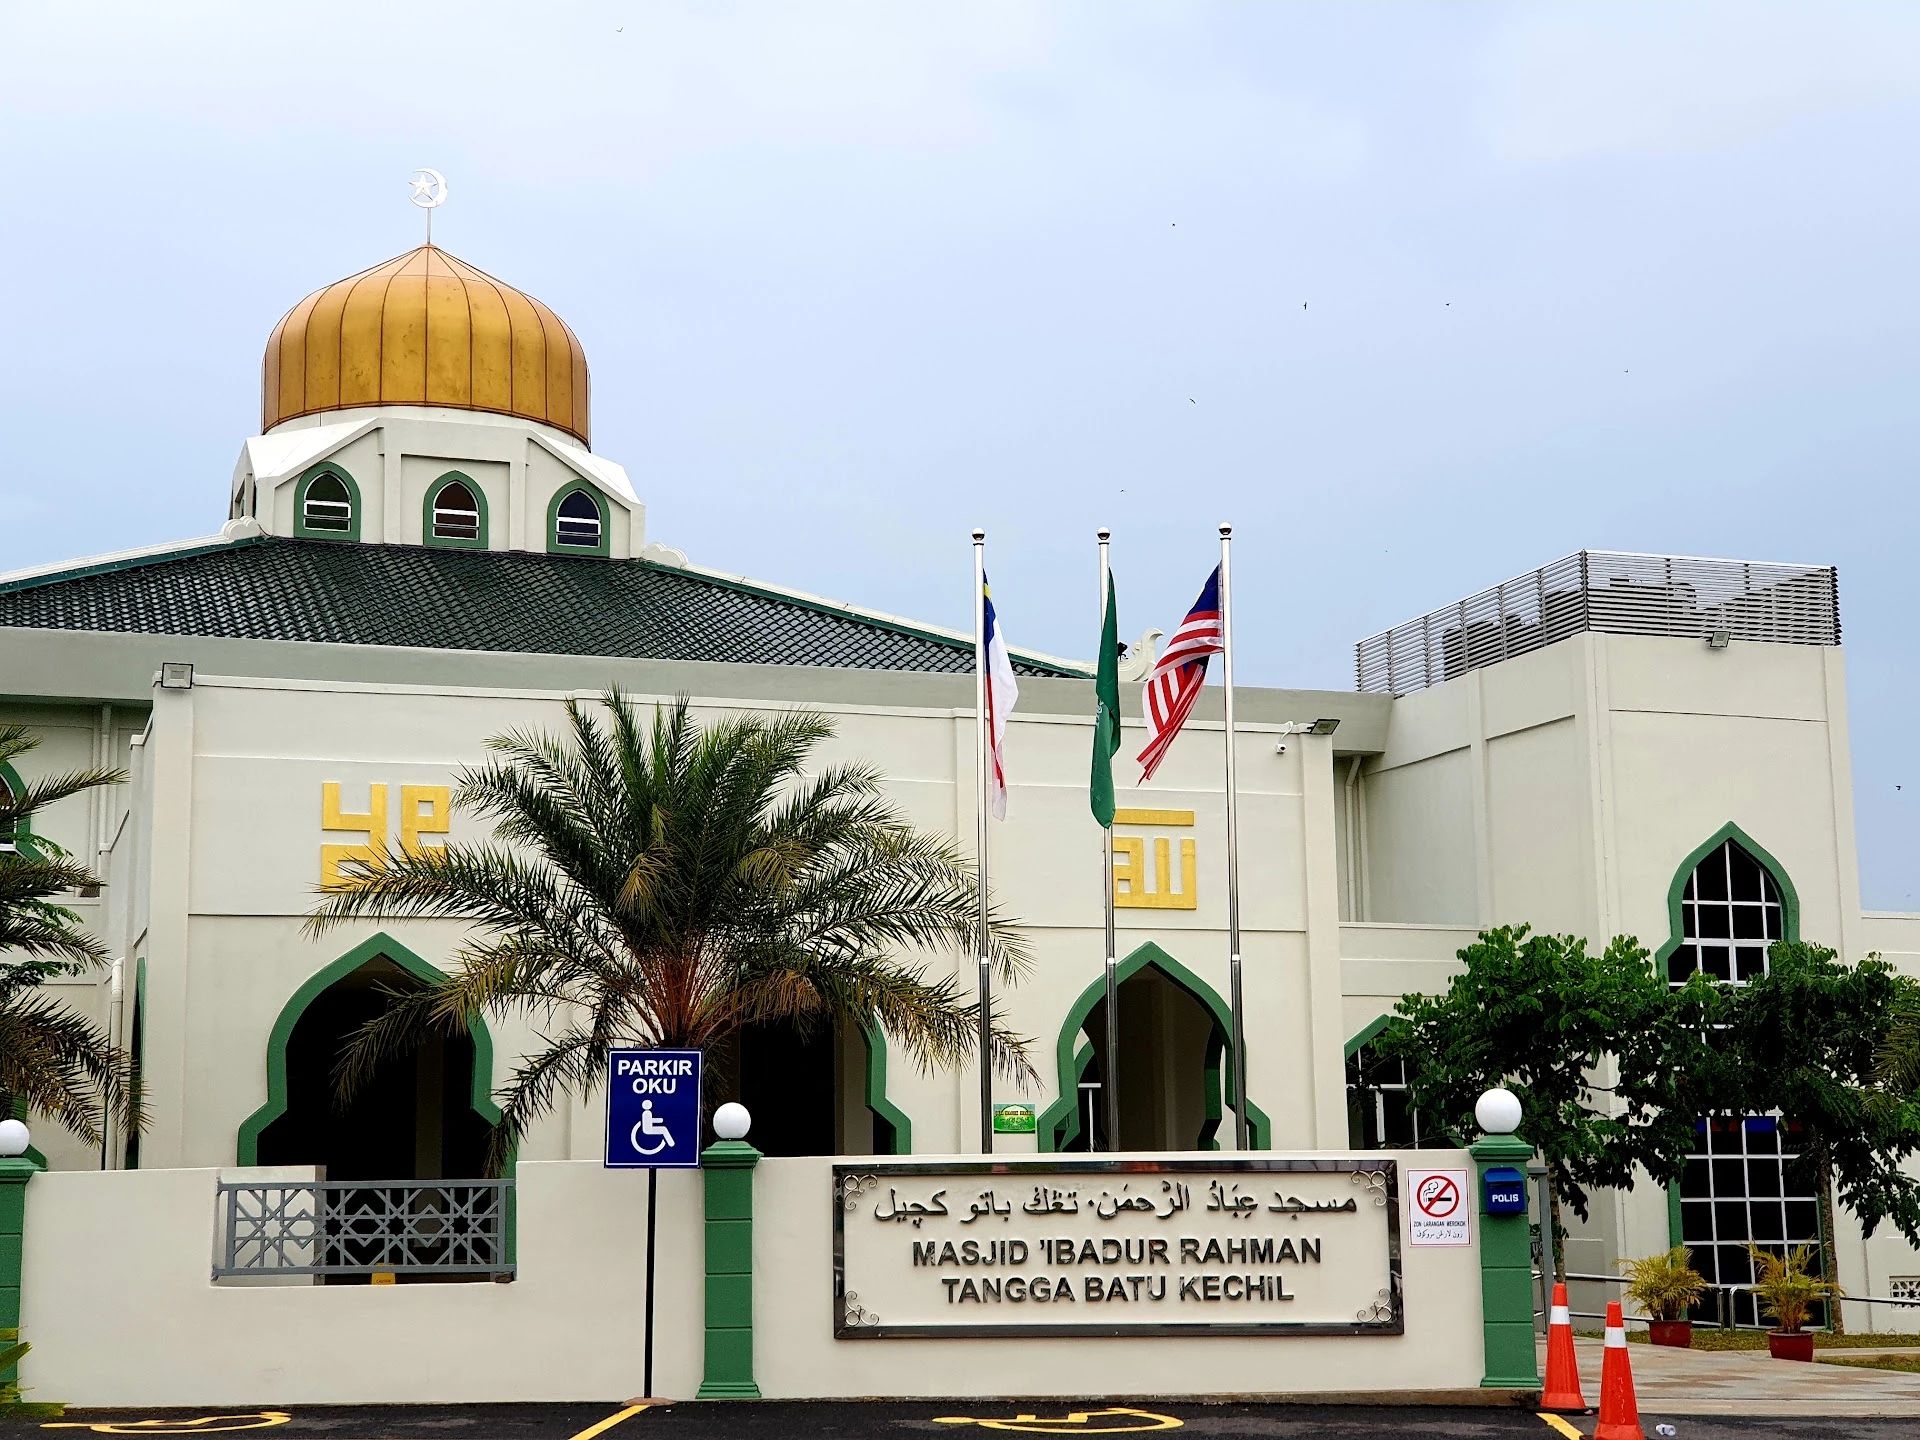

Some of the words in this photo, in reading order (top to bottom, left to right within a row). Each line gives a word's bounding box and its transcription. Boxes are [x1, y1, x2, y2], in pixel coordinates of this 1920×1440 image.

[617, 1059, 693, 1076] PARKIR
[632, 1078, 677, 1095] OKU
[960, 1190, 1012, 1225] باتو
[1268, 1190, 1358, 1222] مسجد
[1492, 1193, 1519, 1203] POLIS
[912, 1240, 1029, 1268] MASJID
[1180, 1237, 1321, 1265] RAHMAN
[941, 1276, 1076, 1304] TANGGA
[1084, 1275, 1166, 1303] BATU
[1178, 1275, 1296, 1302] KECHIL
